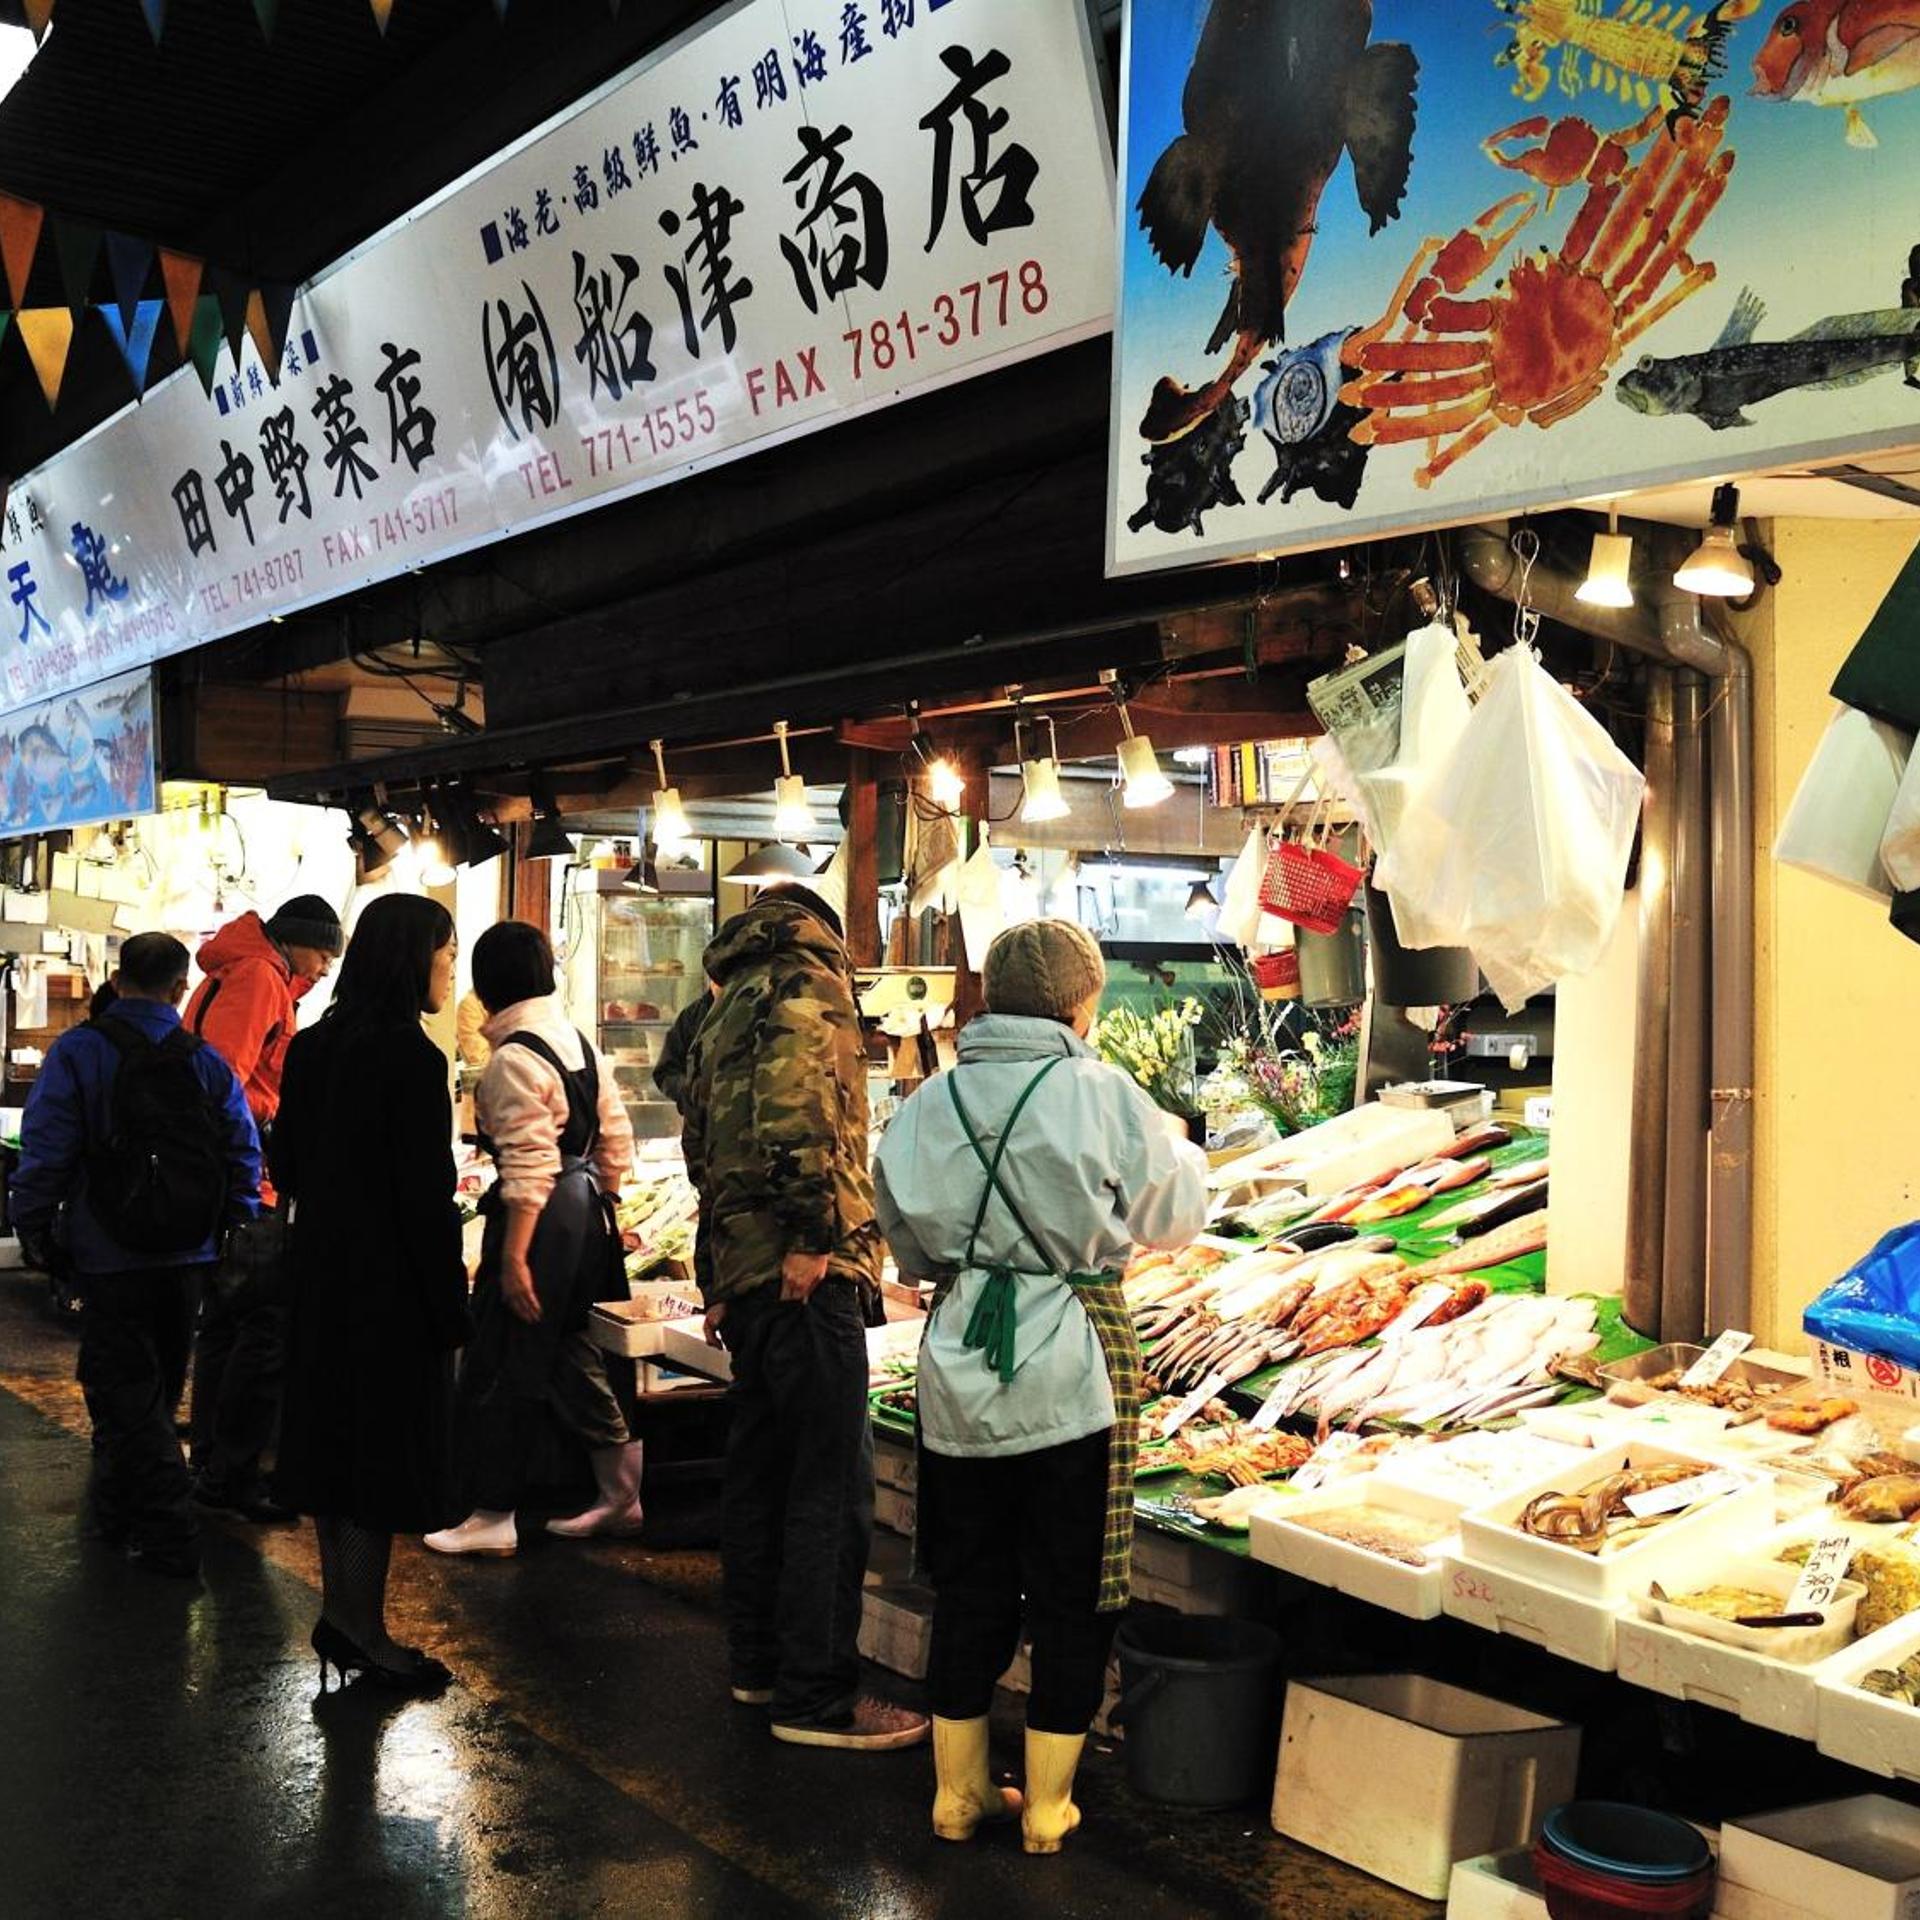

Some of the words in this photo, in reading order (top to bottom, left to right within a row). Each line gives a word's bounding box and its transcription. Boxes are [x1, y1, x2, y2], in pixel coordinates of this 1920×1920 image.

[171, 343, 437, 558] 田中野菜店
[518, 452, 572, 499] TEL
[581, 390, 716, 477] 771-1555
[745, 346, 827, 415] FAX
[842, 258, 1050, 379] 781-3778
[200, 582, 230, 615] TEL
[232, 549, 304, 602] 741-8787
[322, 527, 365, 568] FAX
[370, 487, 459, 550] 741-5717
